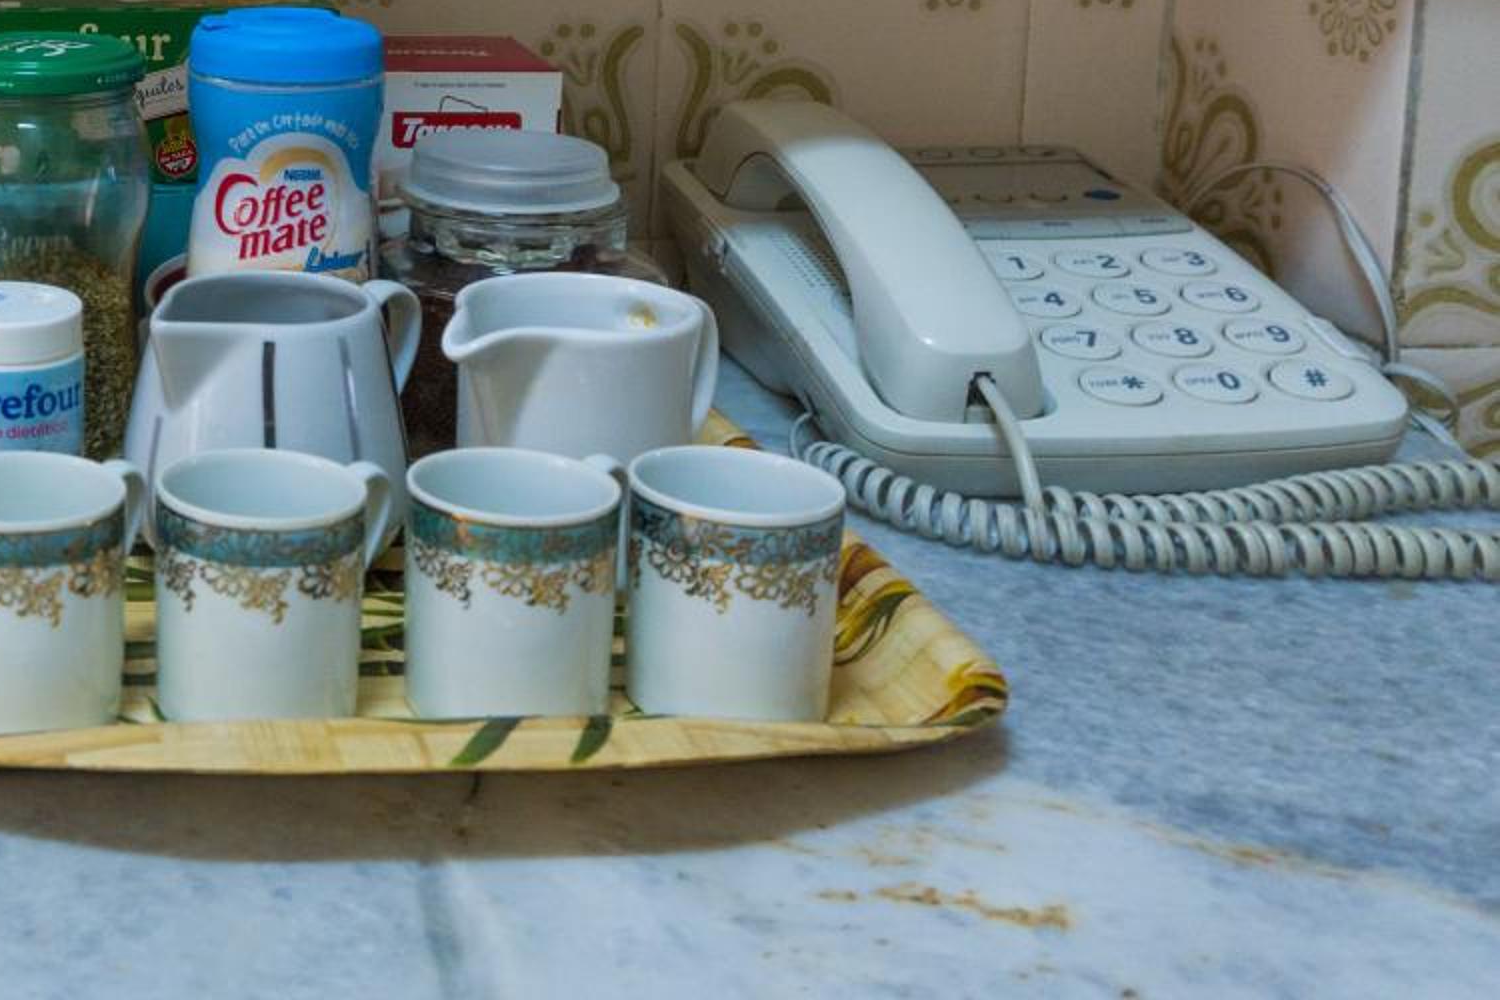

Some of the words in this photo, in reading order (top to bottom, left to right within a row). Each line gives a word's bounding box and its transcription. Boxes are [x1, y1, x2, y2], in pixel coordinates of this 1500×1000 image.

[215, 172, 325, 235] Coffee
[239, 213, 327, 260] mate
[1006, 256, 1025, 270] 1
[1097, 254, 1121, 269] 2
[1182, 251, 1205, 267] 3
[1043, 291, 1066, 307] 4
[1134, 288, 1157, 304] 5
[1224, 286, 1248, 302] 6
[1075, 330, 1097, 347] 7
[1173, 327, 1199, 345] 8
[1265, 325, 1291, 343] 9
[1216, 371, 1241, 390] 0
[1304, 368, 1329, 387] #
